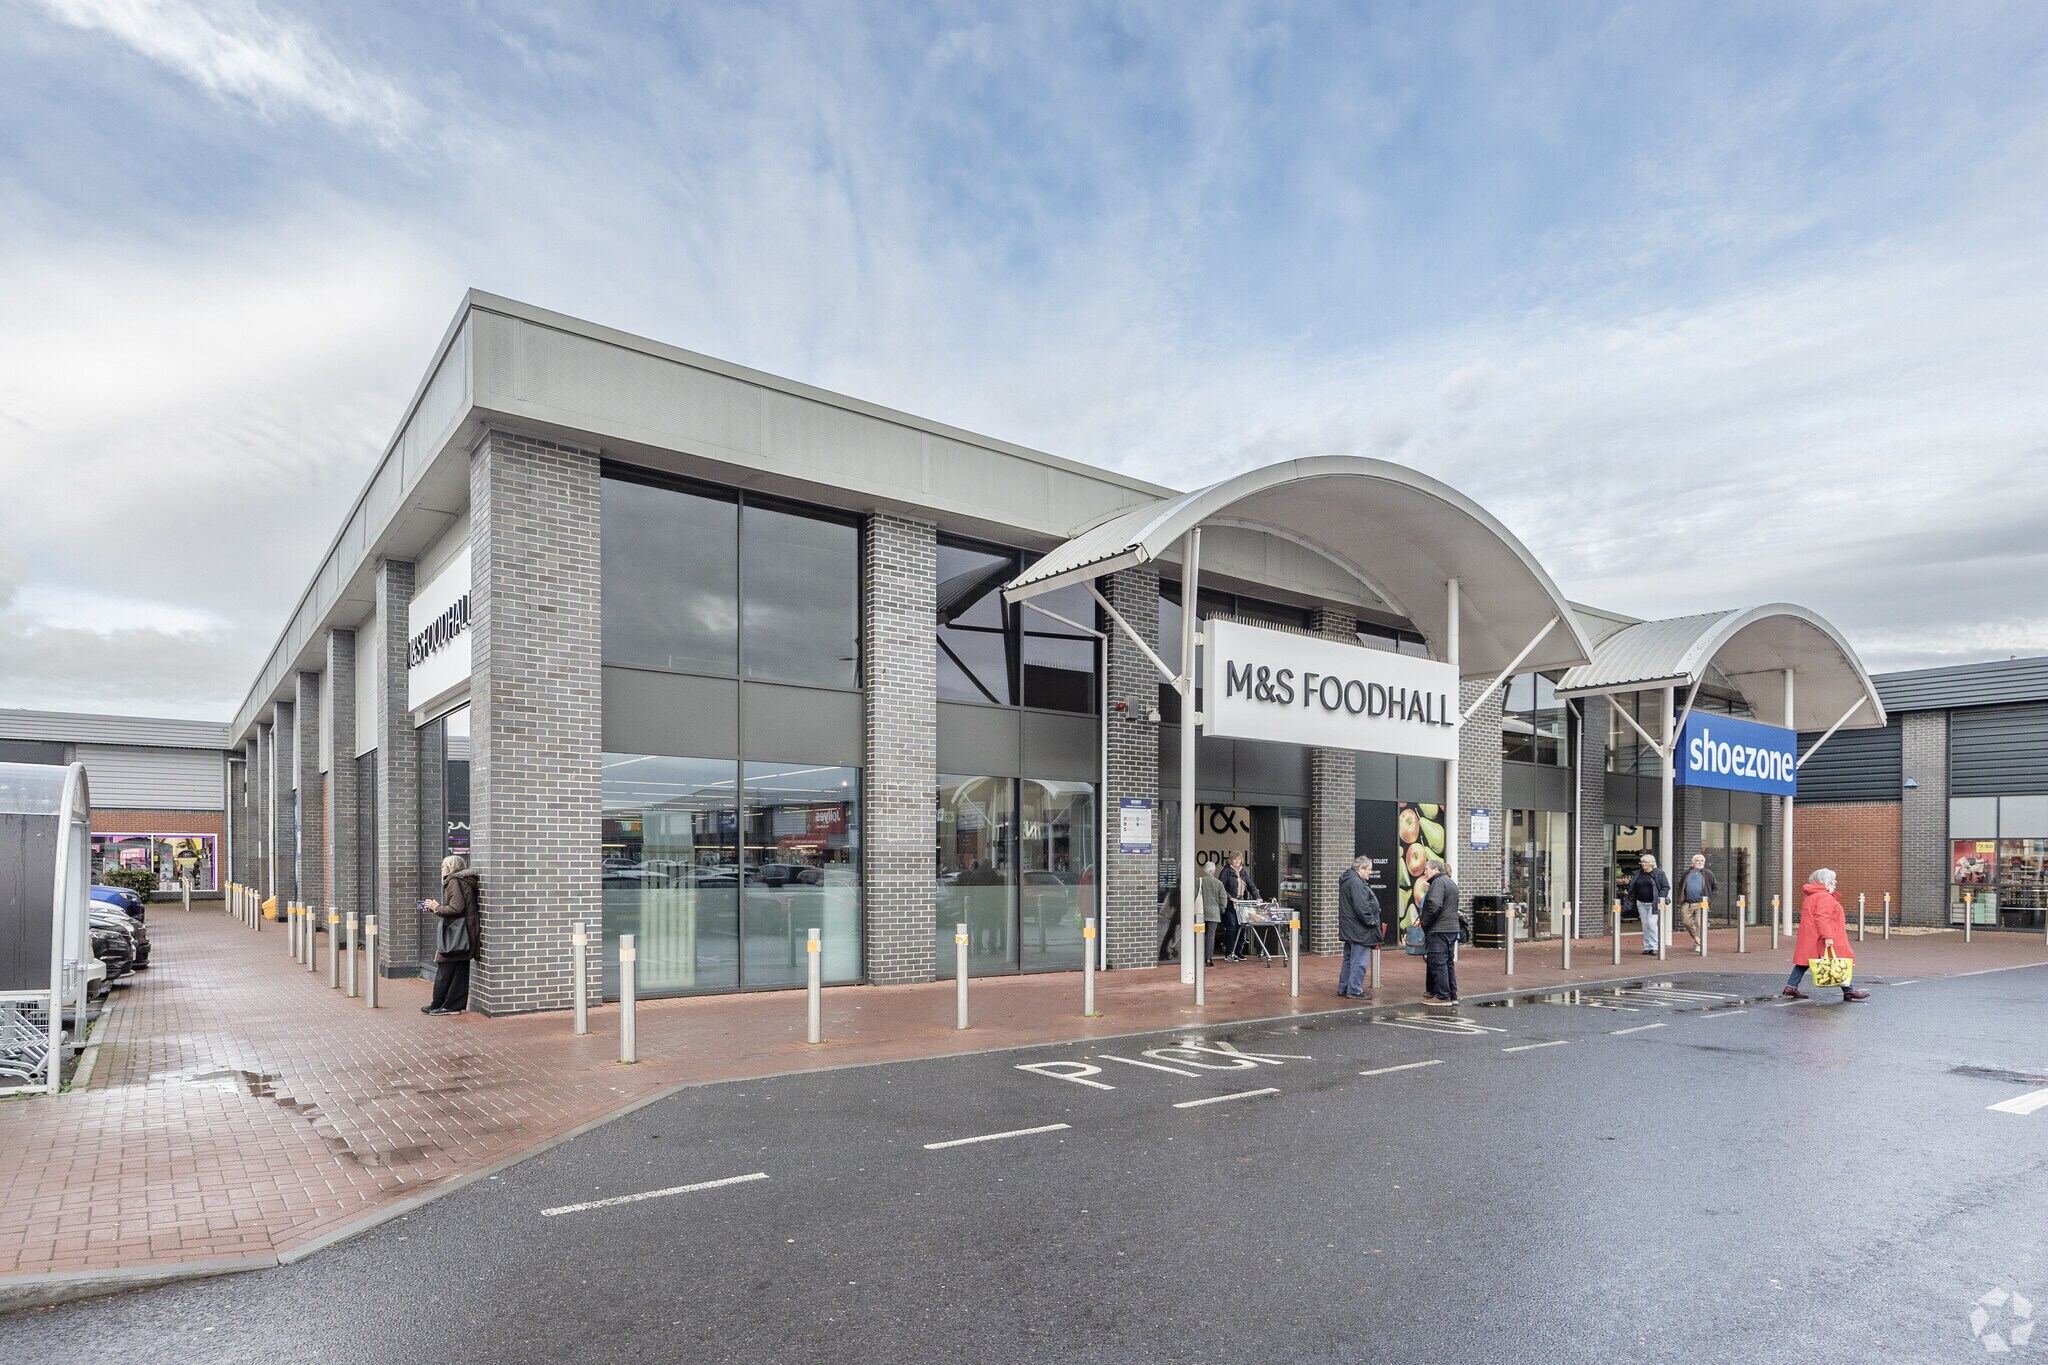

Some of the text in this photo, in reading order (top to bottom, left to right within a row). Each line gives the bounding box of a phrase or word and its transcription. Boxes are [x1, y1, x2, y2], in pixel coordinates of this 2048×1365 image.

[1226, 659, 1454, 726] M&S FOODHALL
[1690, 728, 1794, 783] shoezone
[1014, 1040, 1312, 1091] PICK
[1371, 1015, 1508, 1035] UP
